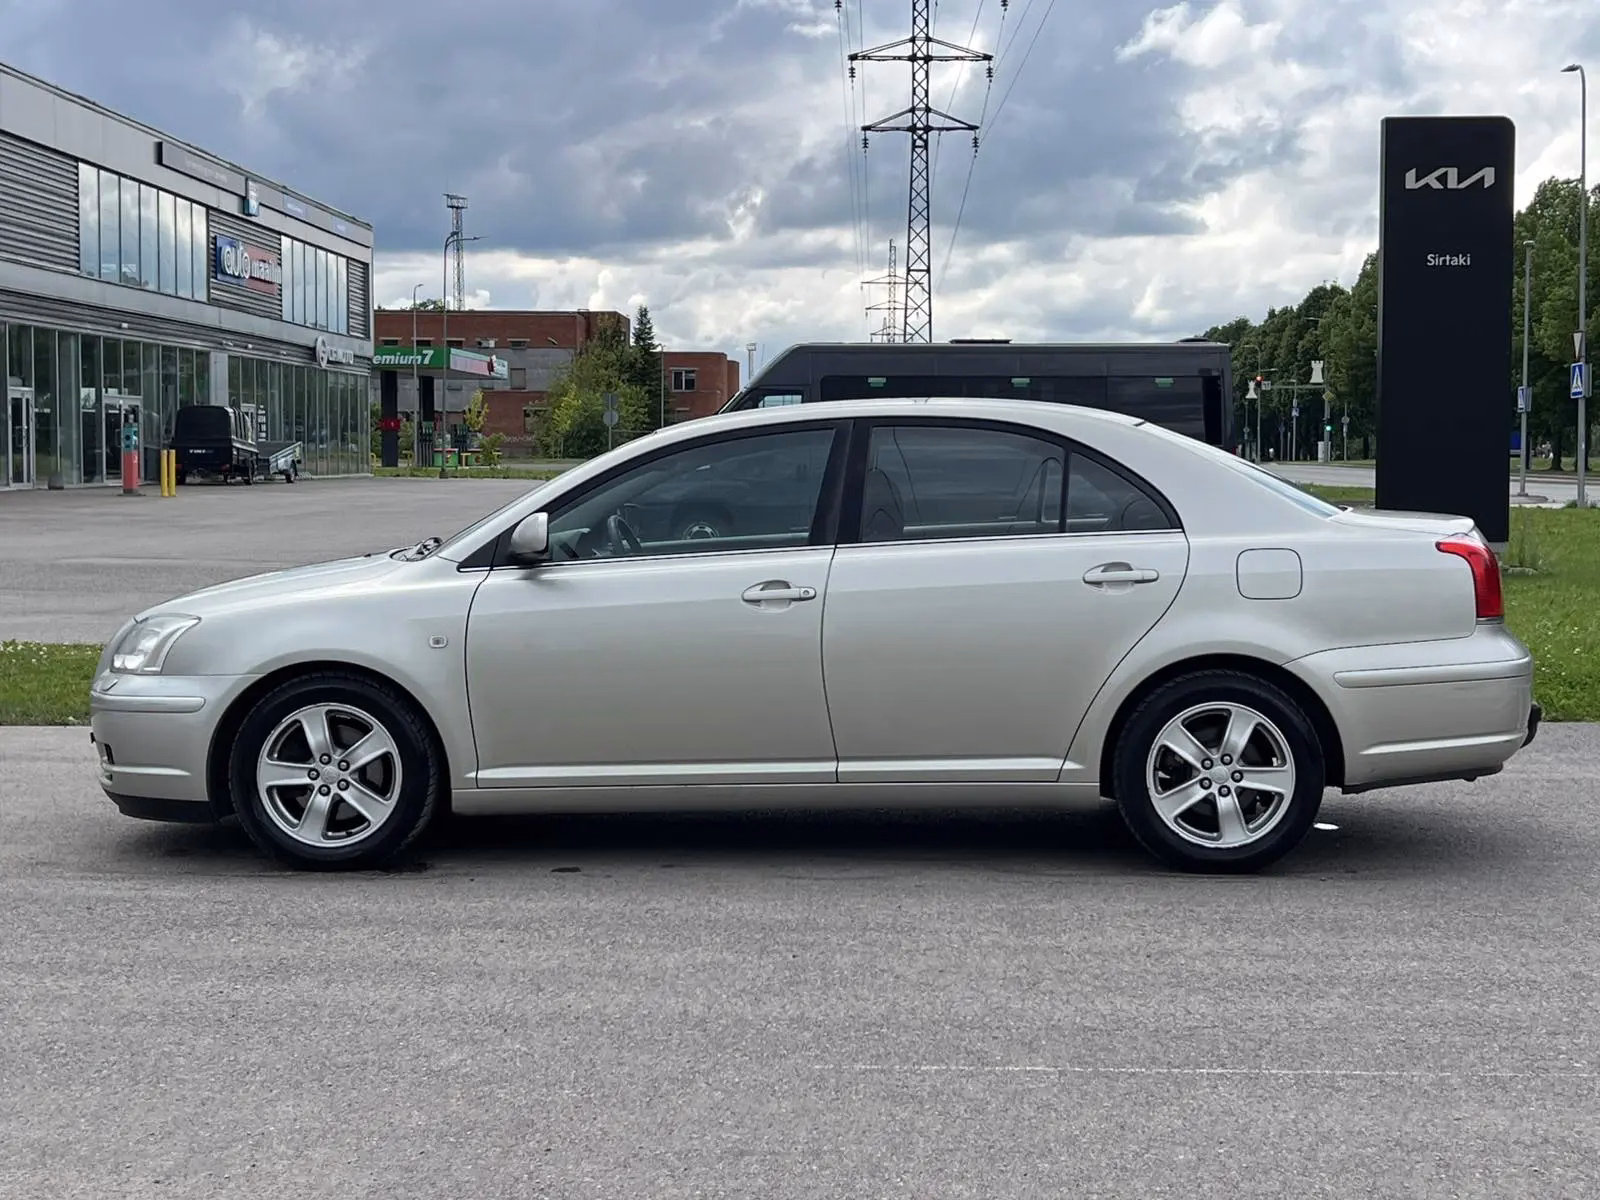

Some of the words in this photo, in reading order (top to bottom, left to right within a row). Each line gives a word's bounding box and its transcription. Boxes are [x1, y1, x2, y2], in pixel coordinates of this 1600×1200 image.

[1405, 166, 1495, 189] KIA
[221, 241, 251, 279] auto
[1426, 253, 1471, 266] Sirtaki
[372, 349, 434, 365] emium7
